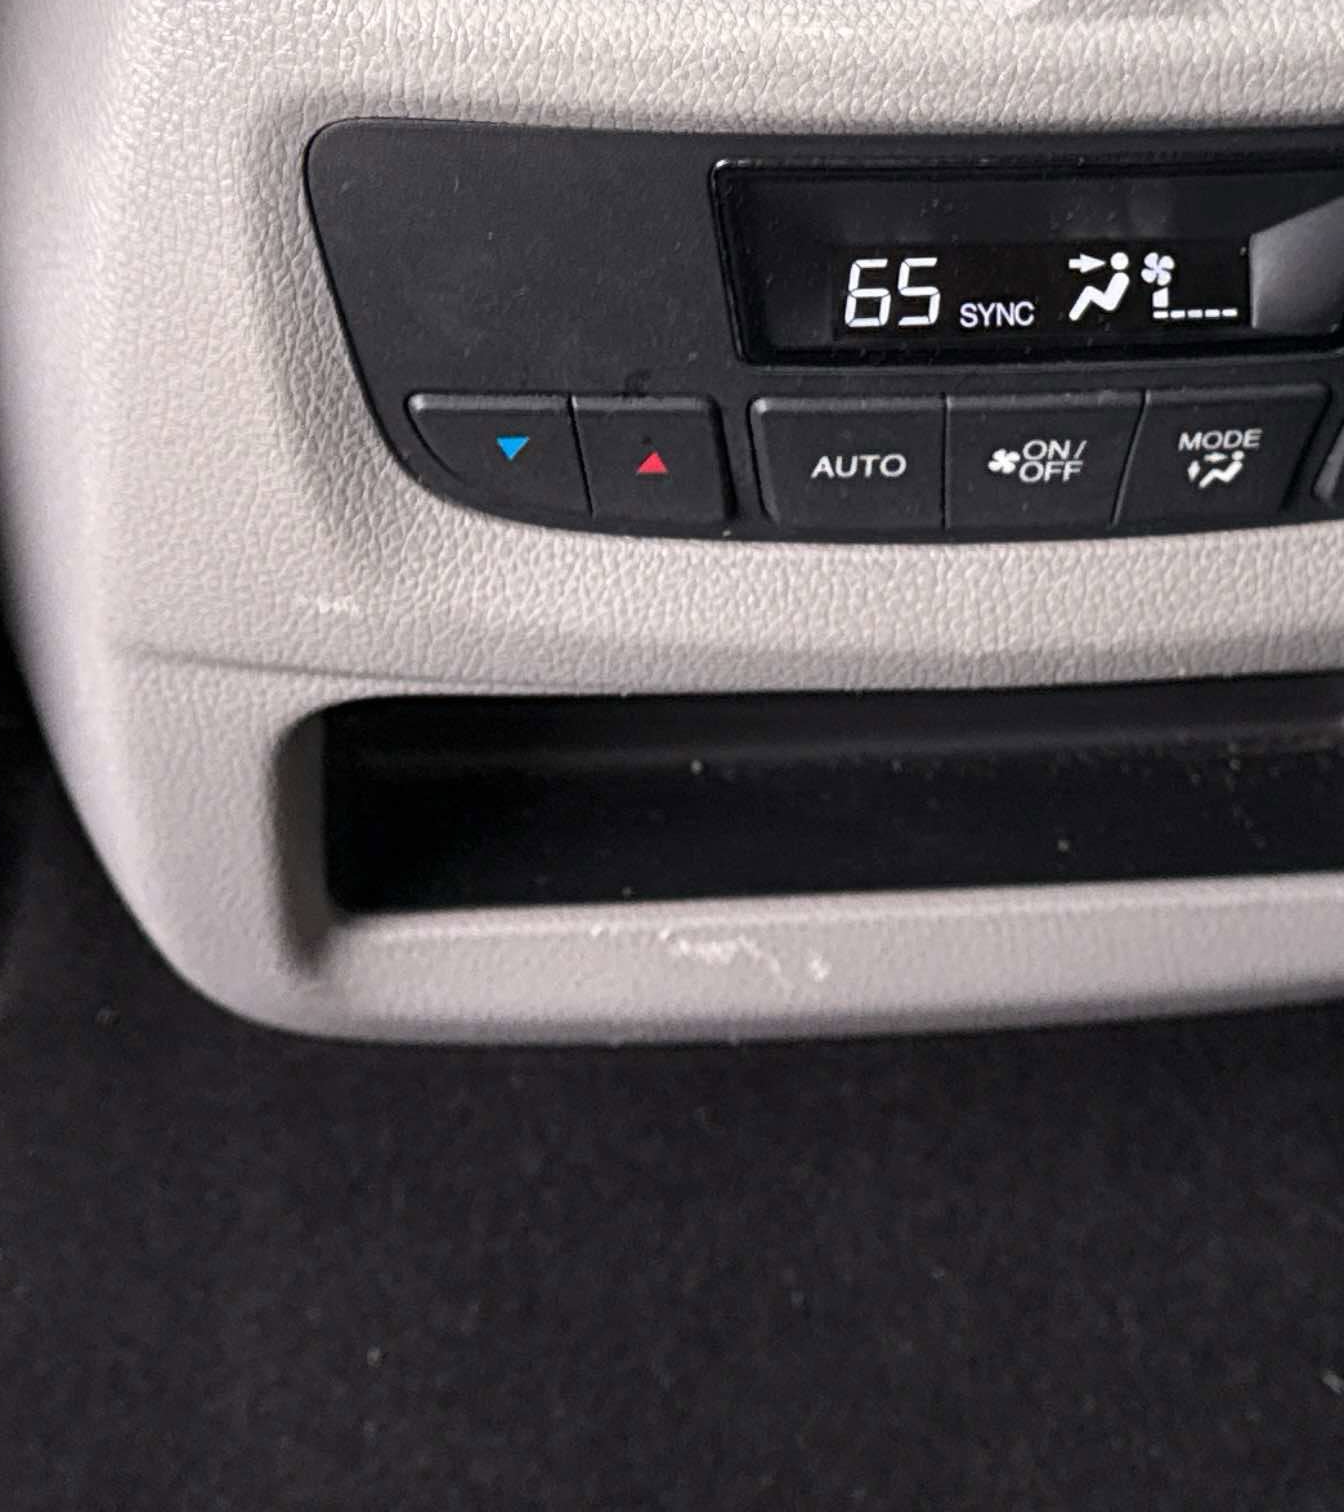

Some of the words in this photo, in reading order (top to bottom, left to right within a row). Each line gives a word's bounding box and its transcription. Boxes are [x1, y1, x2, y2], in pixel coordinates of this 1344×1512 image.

[844, 256, 941, 328] 65
[959, 300, 1035, 328] SYNC
[1022, 438, 1087, 460] ON/
[1178, 428, 1262, 451] MODE
[810, 453, 907, 479] AUTO
[1018, 459, 1084, 483] OFF
